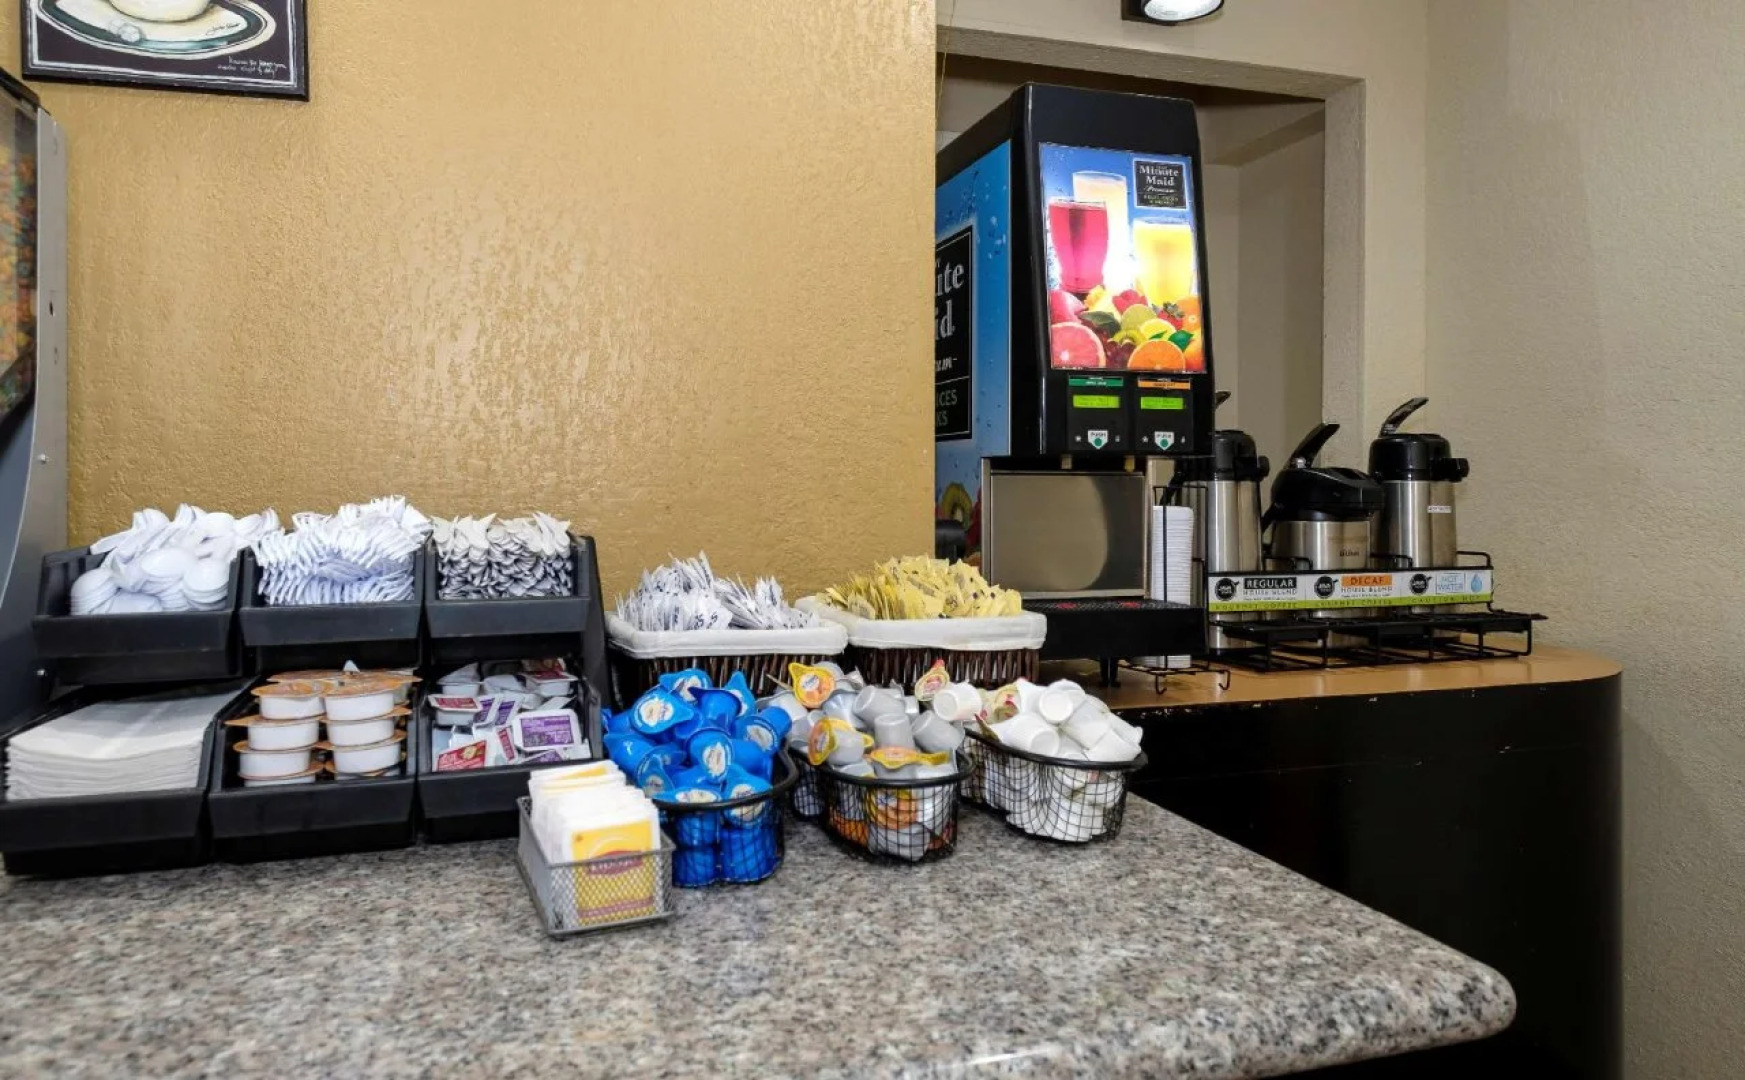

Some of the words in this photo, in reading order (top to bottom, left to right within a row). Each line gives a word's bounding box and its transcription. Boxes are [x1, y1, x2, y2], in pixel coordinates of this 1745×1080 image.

[1146, 175, 1175, 186] Maid
[1246, 579, 1294, 588] REGULAR
[1350, 576, 1385, 586] DECAF
[1438, 583, 1463, 591] WATER
